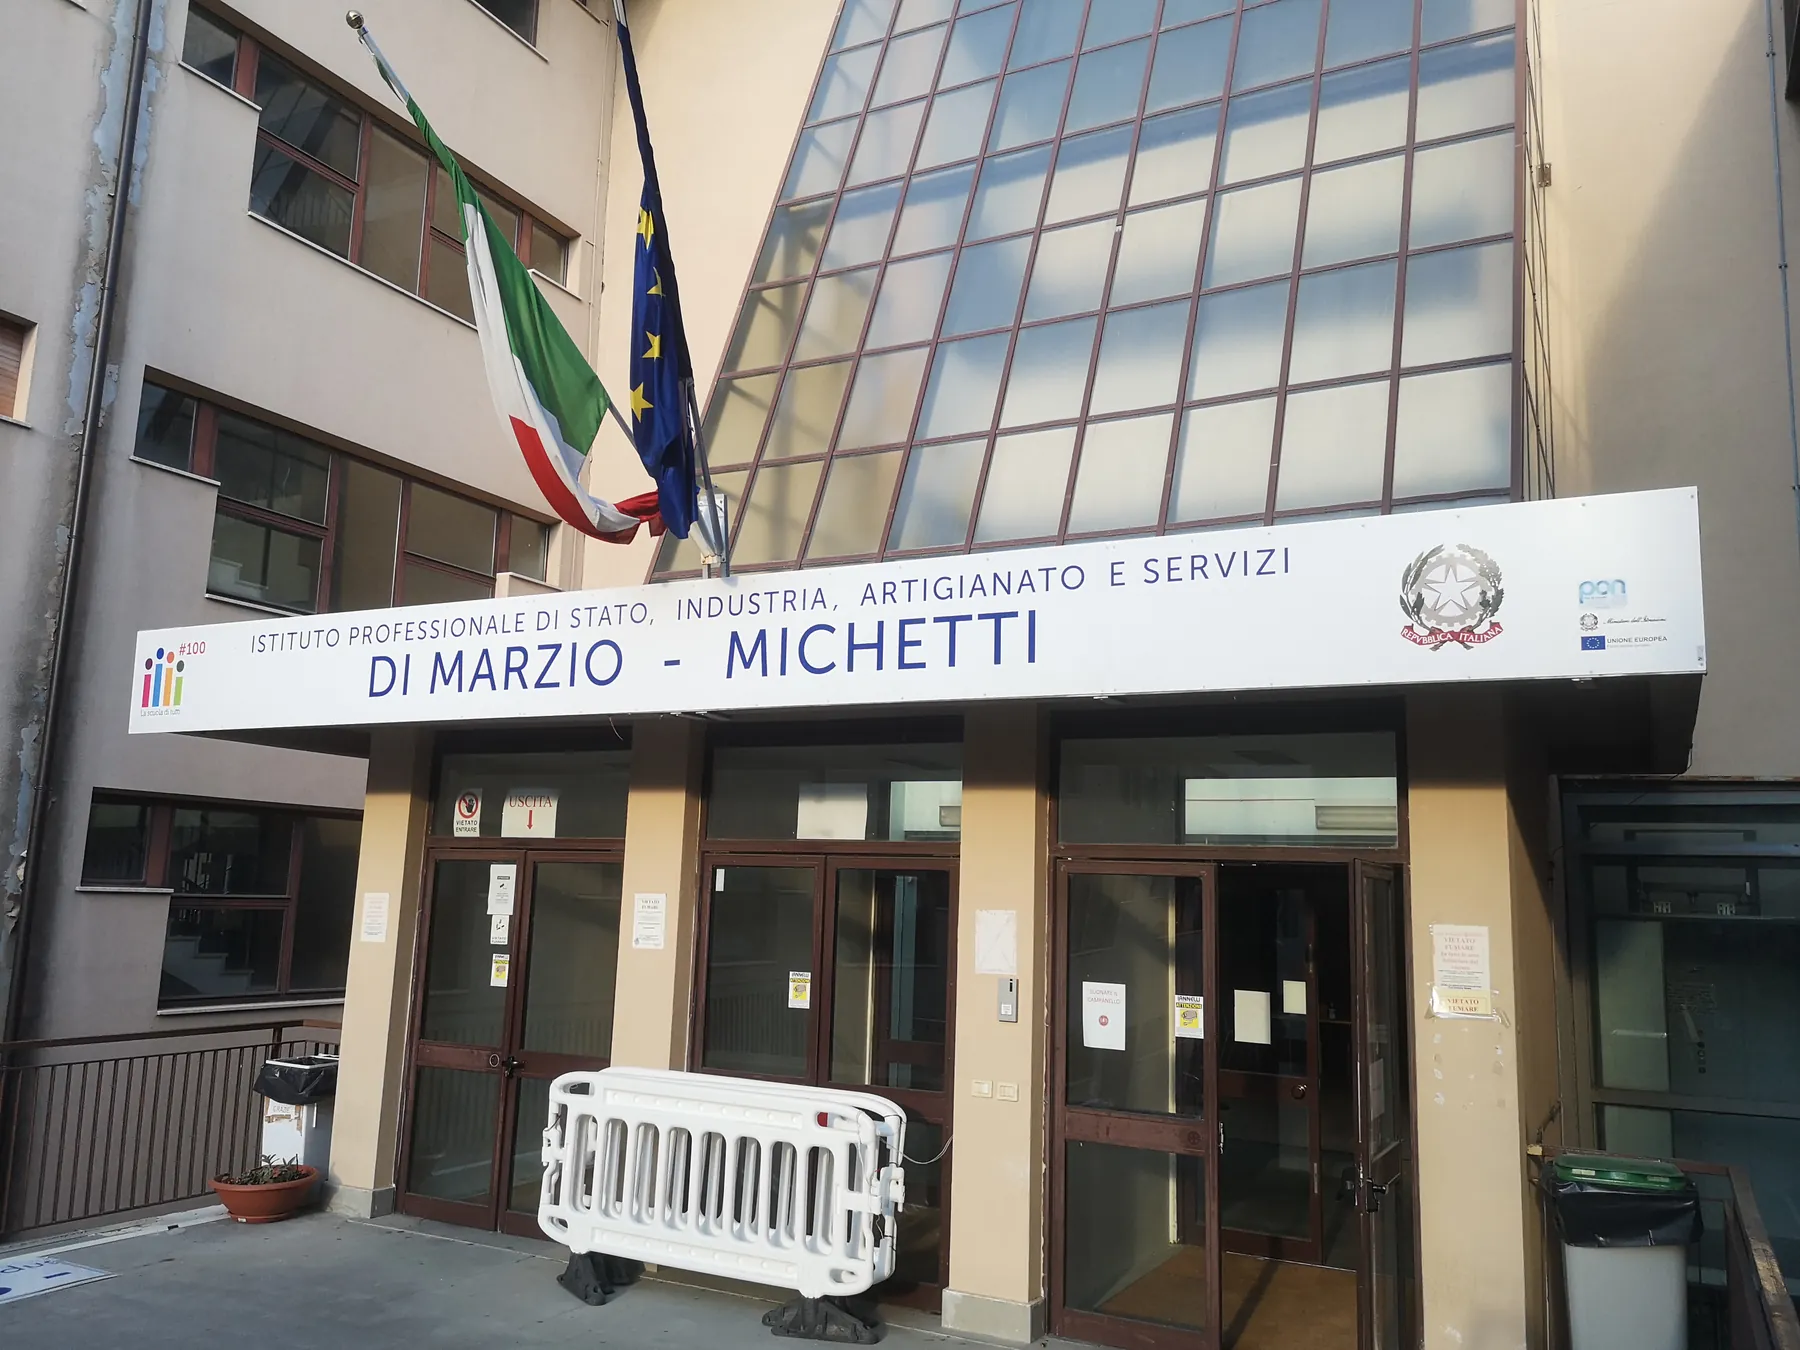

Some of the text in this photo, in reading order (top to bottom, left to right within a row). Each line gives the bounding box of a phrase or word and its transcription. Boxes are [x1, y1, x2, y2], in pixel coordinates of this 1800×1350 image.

[251, 547, 1290, 654] ISTITUTO PROFESSIONALE DI STATO, INDUSTRIA, ARTIGIANATO E SERVIZI
[1459, 626, 1503, 643] ITALIANA
[179, 641, 206, 655] #100
[368, 608, 1037, 698] DI MARZIO - MICHETTI
[509, 795, 553, 808] USCITA
